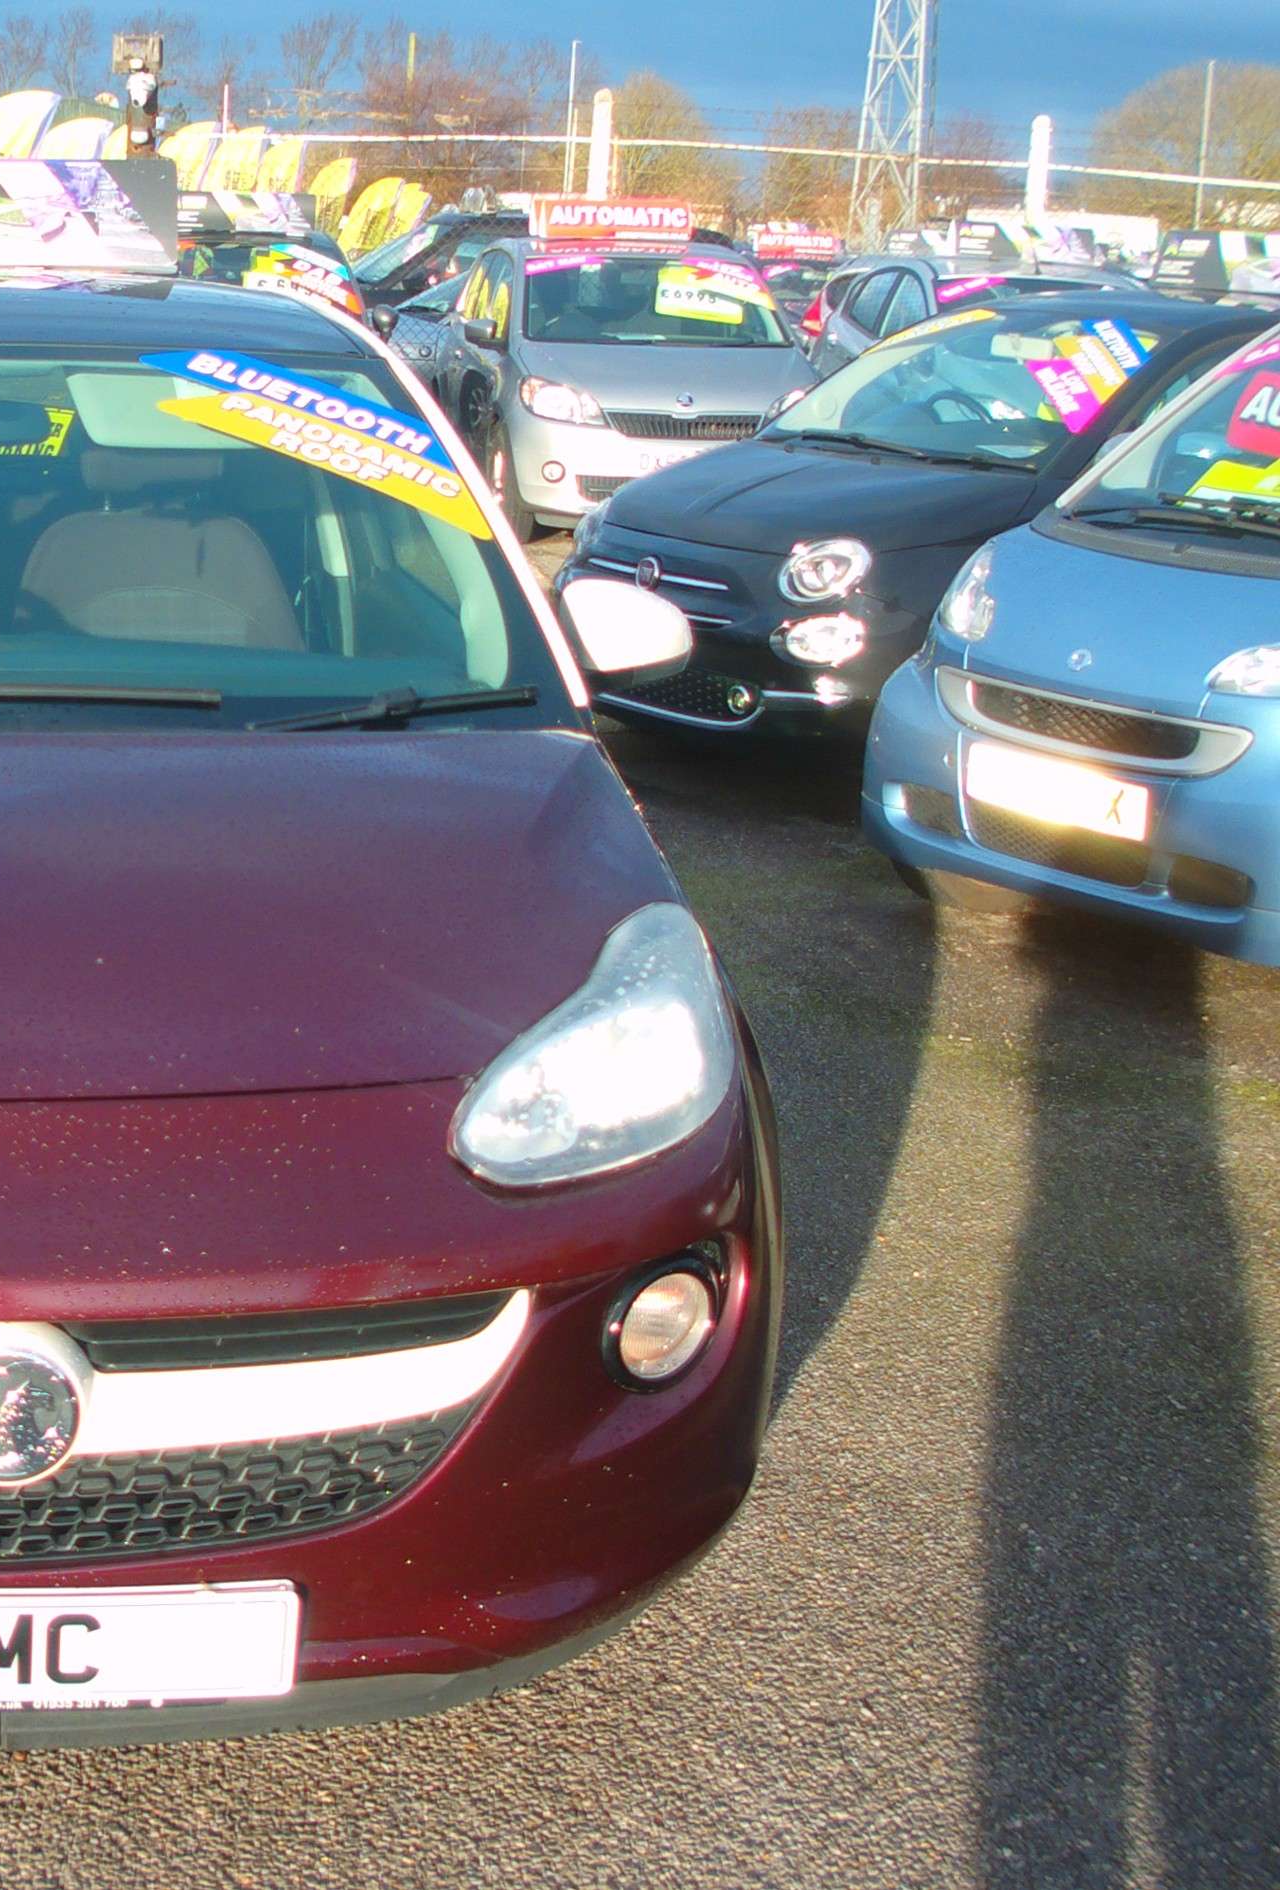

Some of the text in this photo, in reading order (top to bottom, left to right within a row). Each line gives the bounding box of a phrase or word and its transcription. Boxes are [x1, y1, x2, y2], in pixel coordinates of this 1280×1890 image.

[549, 205, 688, 228] AUTOMATIC
[186, 352, 431, 454] BLUETOOTH
[221, 395, 462, 498] PANORAMIC
[269, 430, 389, 482] ROOF
